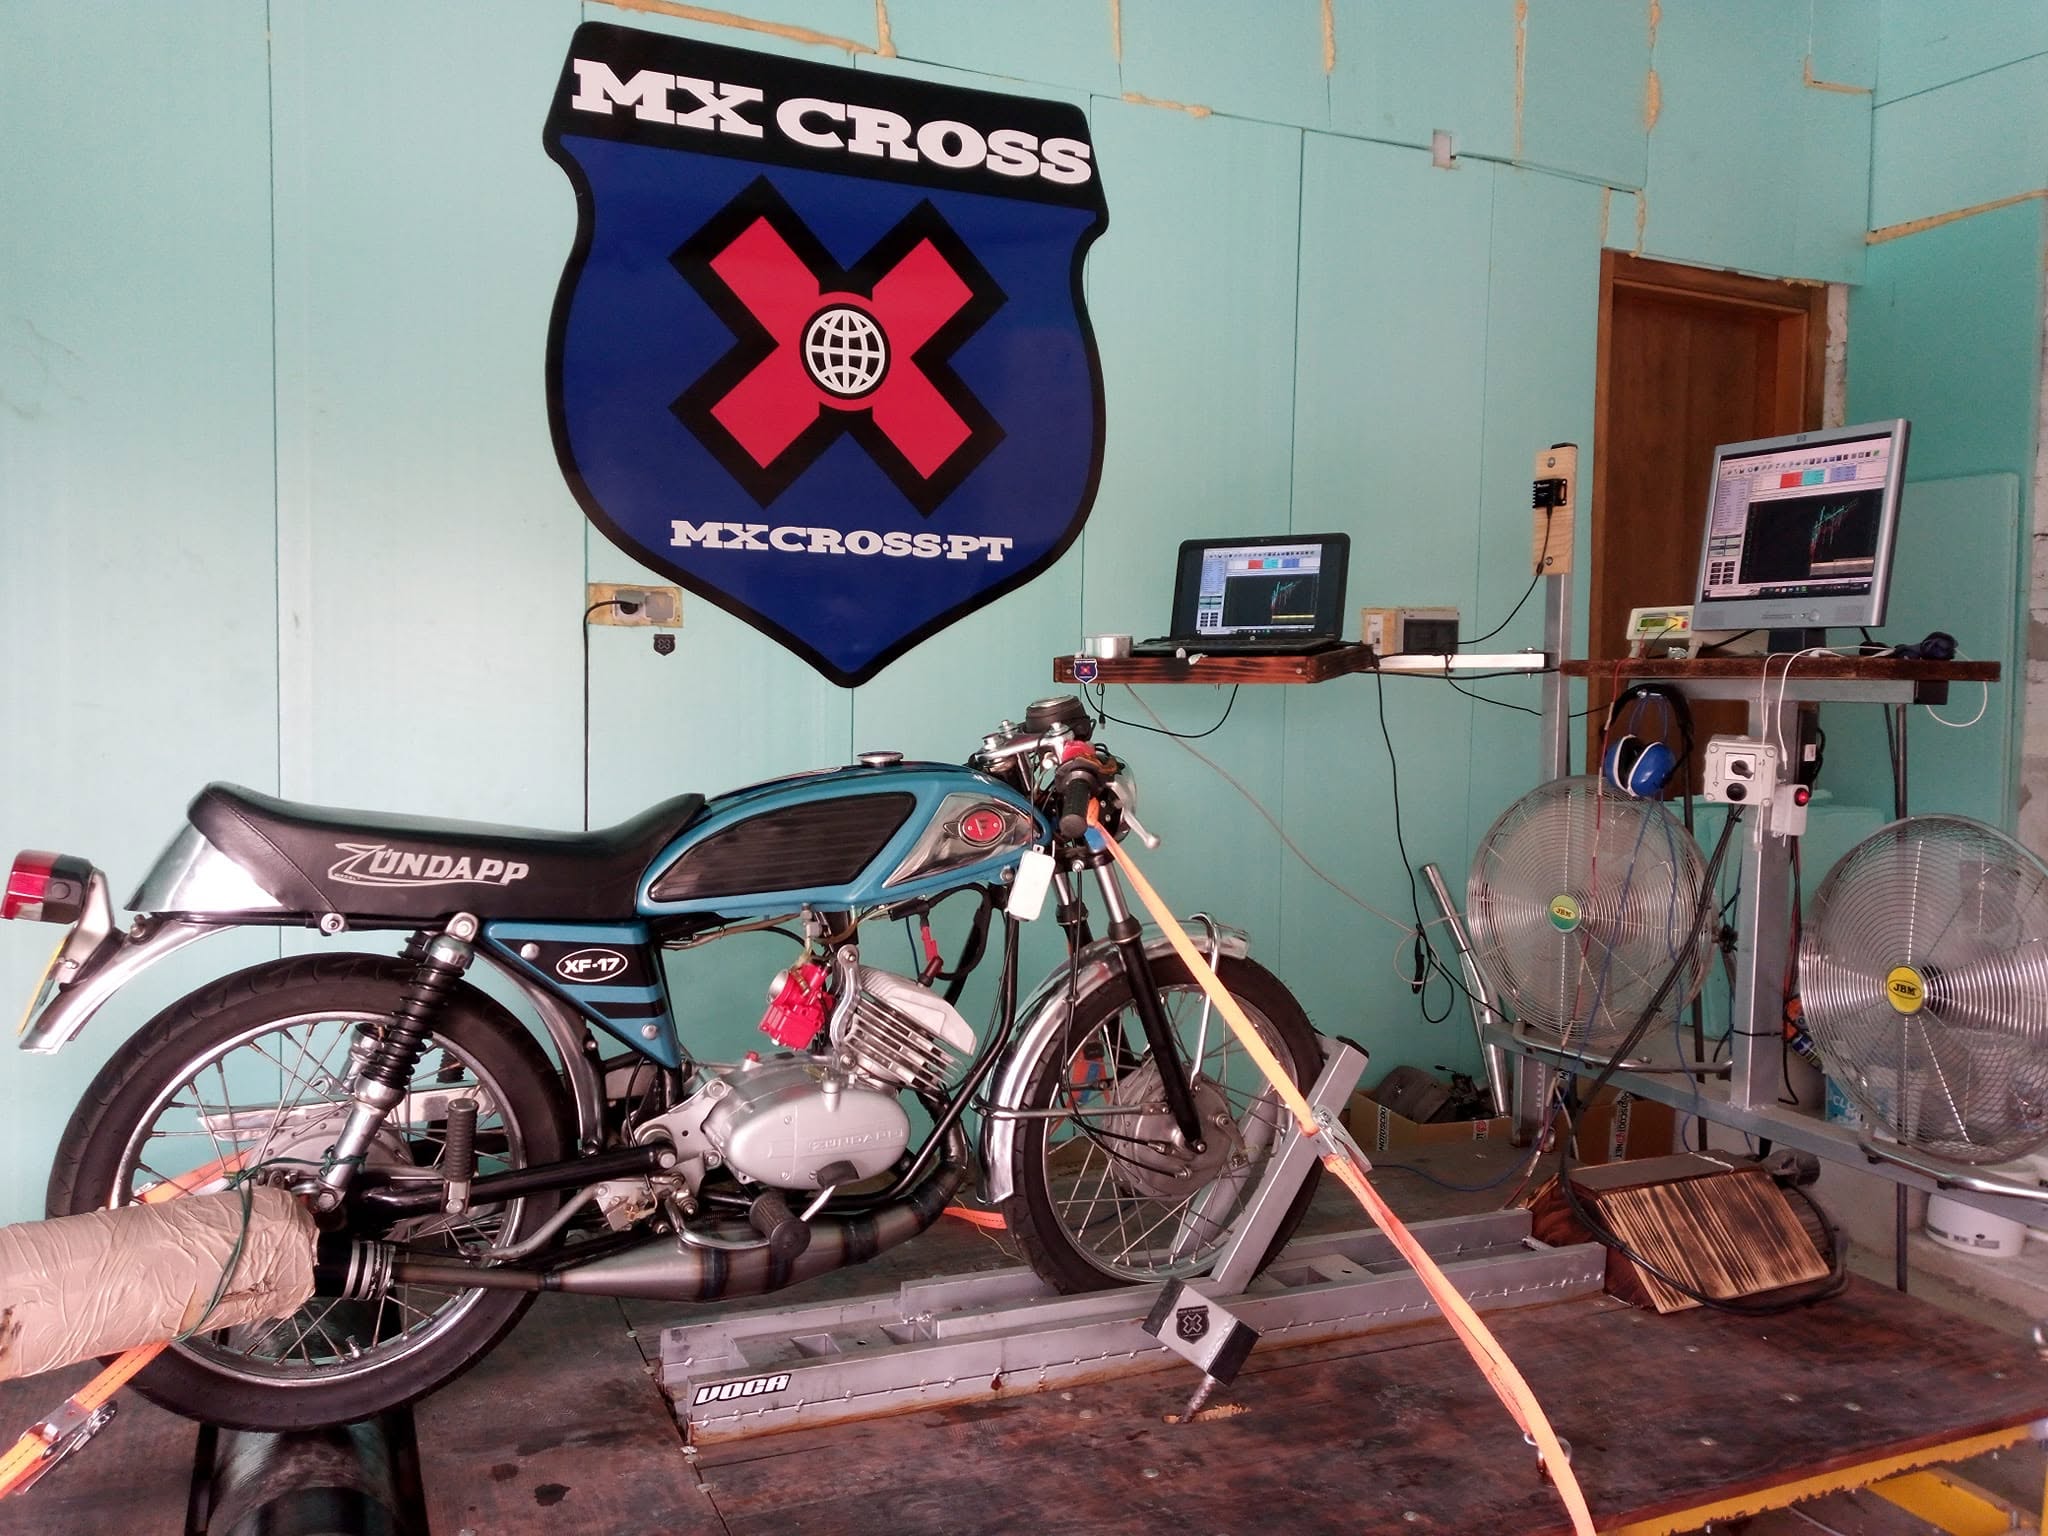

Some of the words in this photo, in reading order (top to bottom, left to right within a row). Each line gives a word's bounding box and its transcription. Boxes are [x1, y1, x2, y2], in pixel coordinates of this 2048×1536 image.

[572, 58, 764, 138] MX
[776, 98, 1092, 185] CROSS
[563, 957, 620, 974] XF-17
[1893, 983, 1917, 996] JBM
